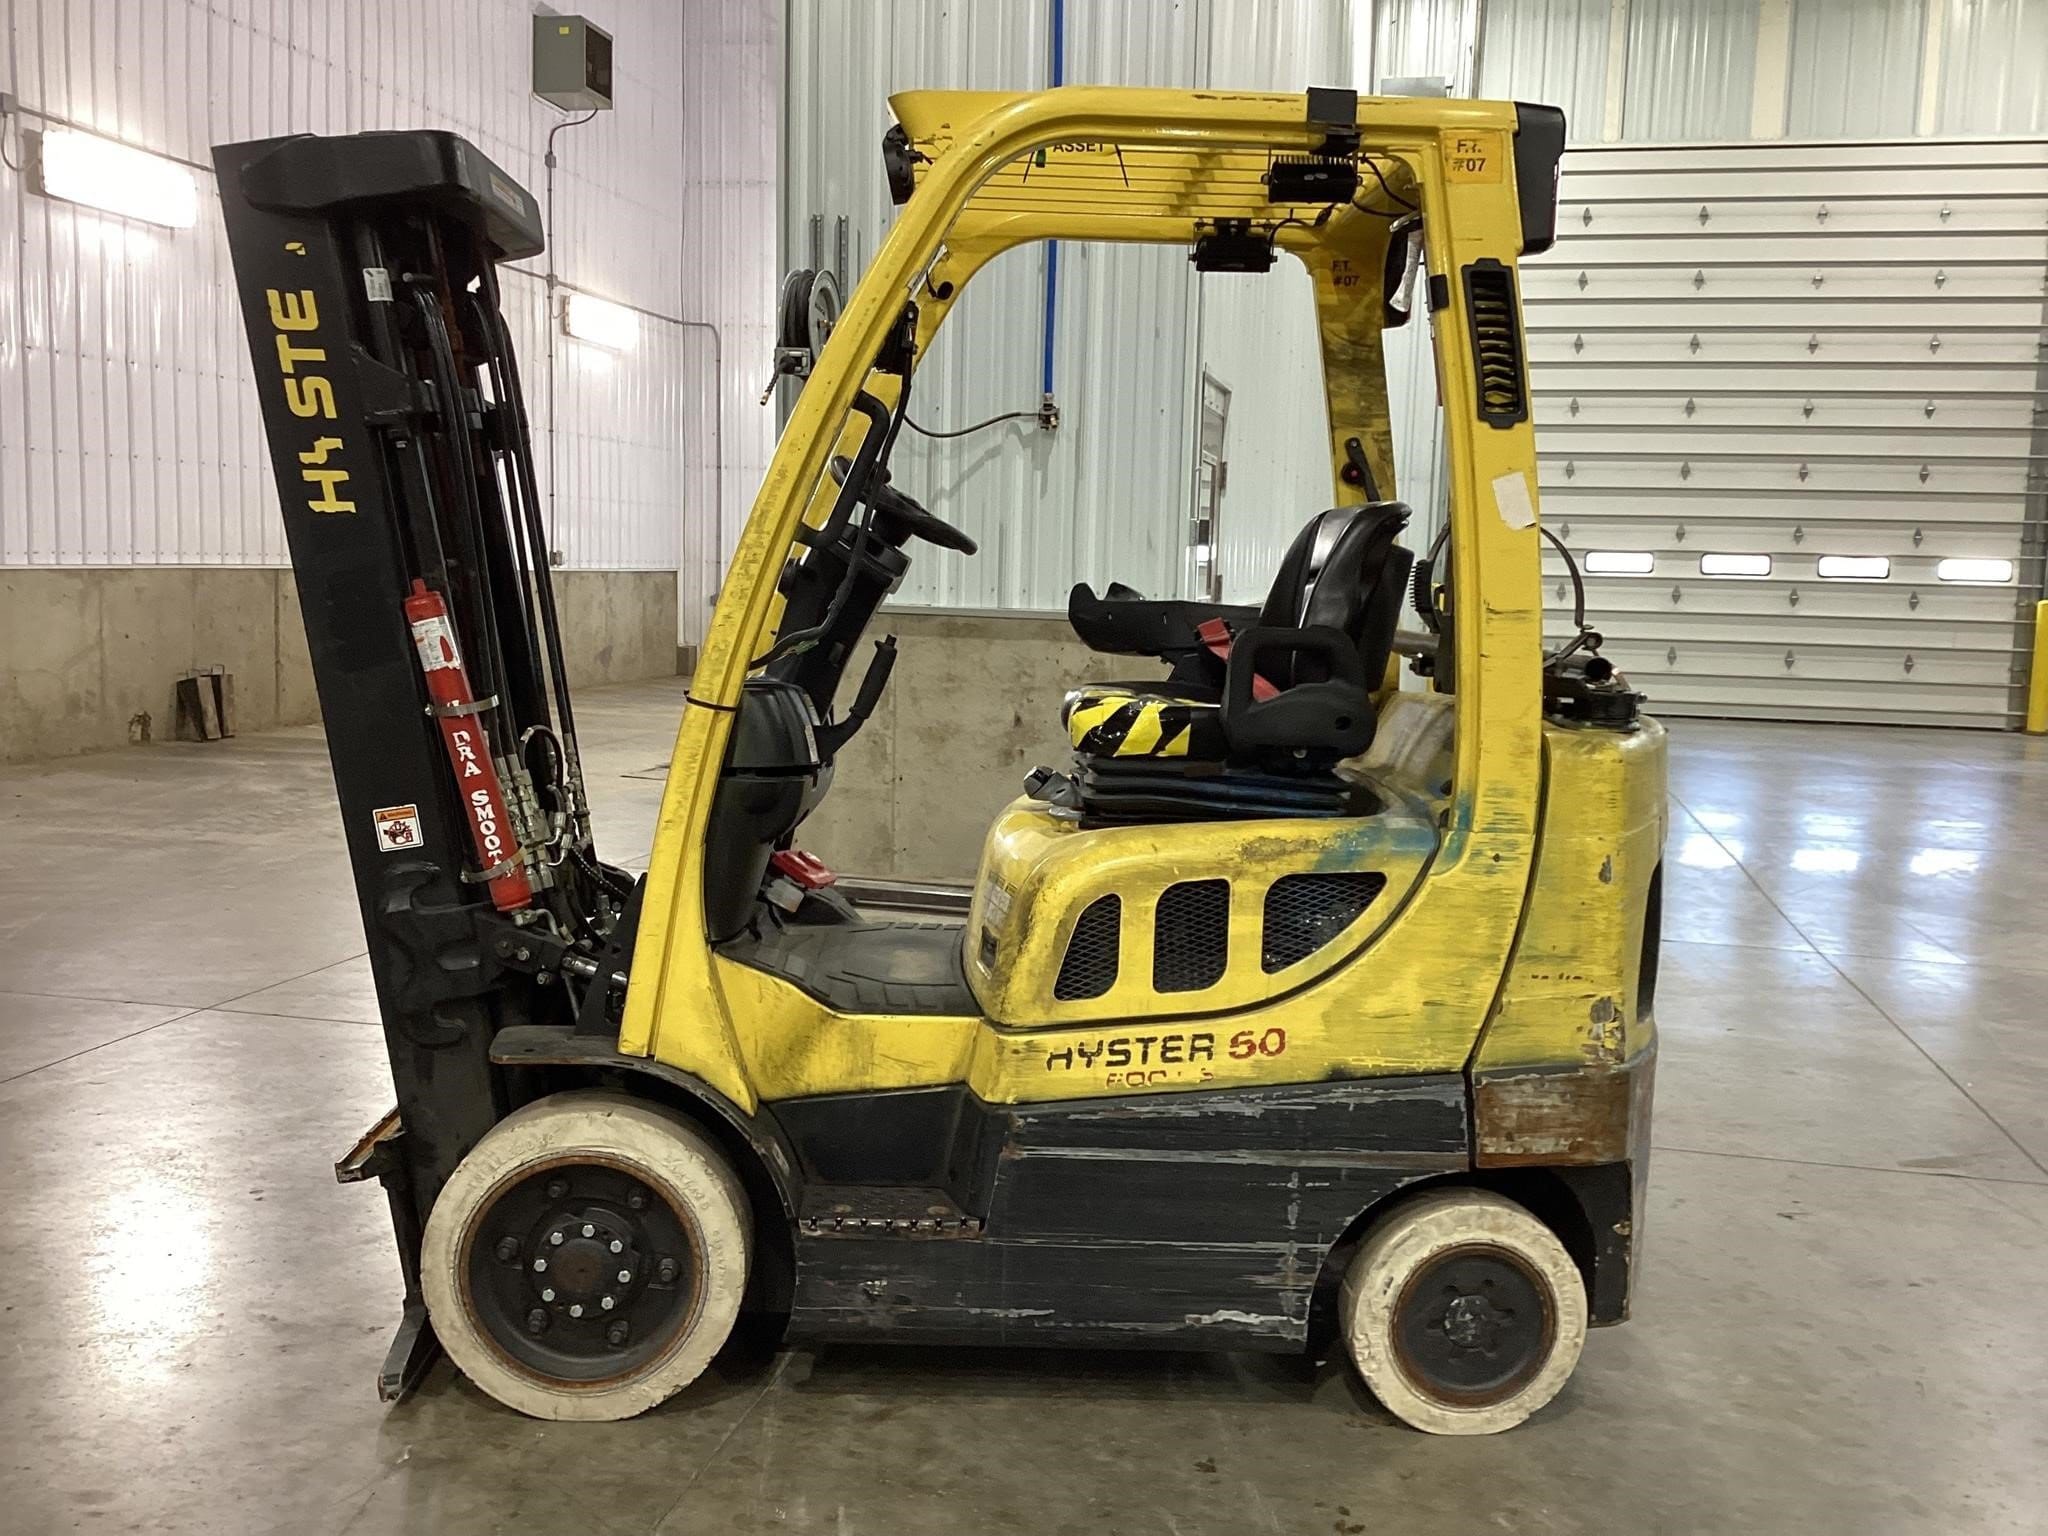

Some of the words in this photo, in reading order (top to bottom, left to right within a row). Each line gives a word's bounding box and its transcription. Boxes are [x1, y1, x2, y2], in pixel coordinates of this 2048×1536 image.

[266, 242, 357, 513] HYSTE
[471, 789, 515, 878] SMOOT
[1047, 1033, 1214, 1071] HYSTER
[1229, 1028, 1286, 1059] 50
